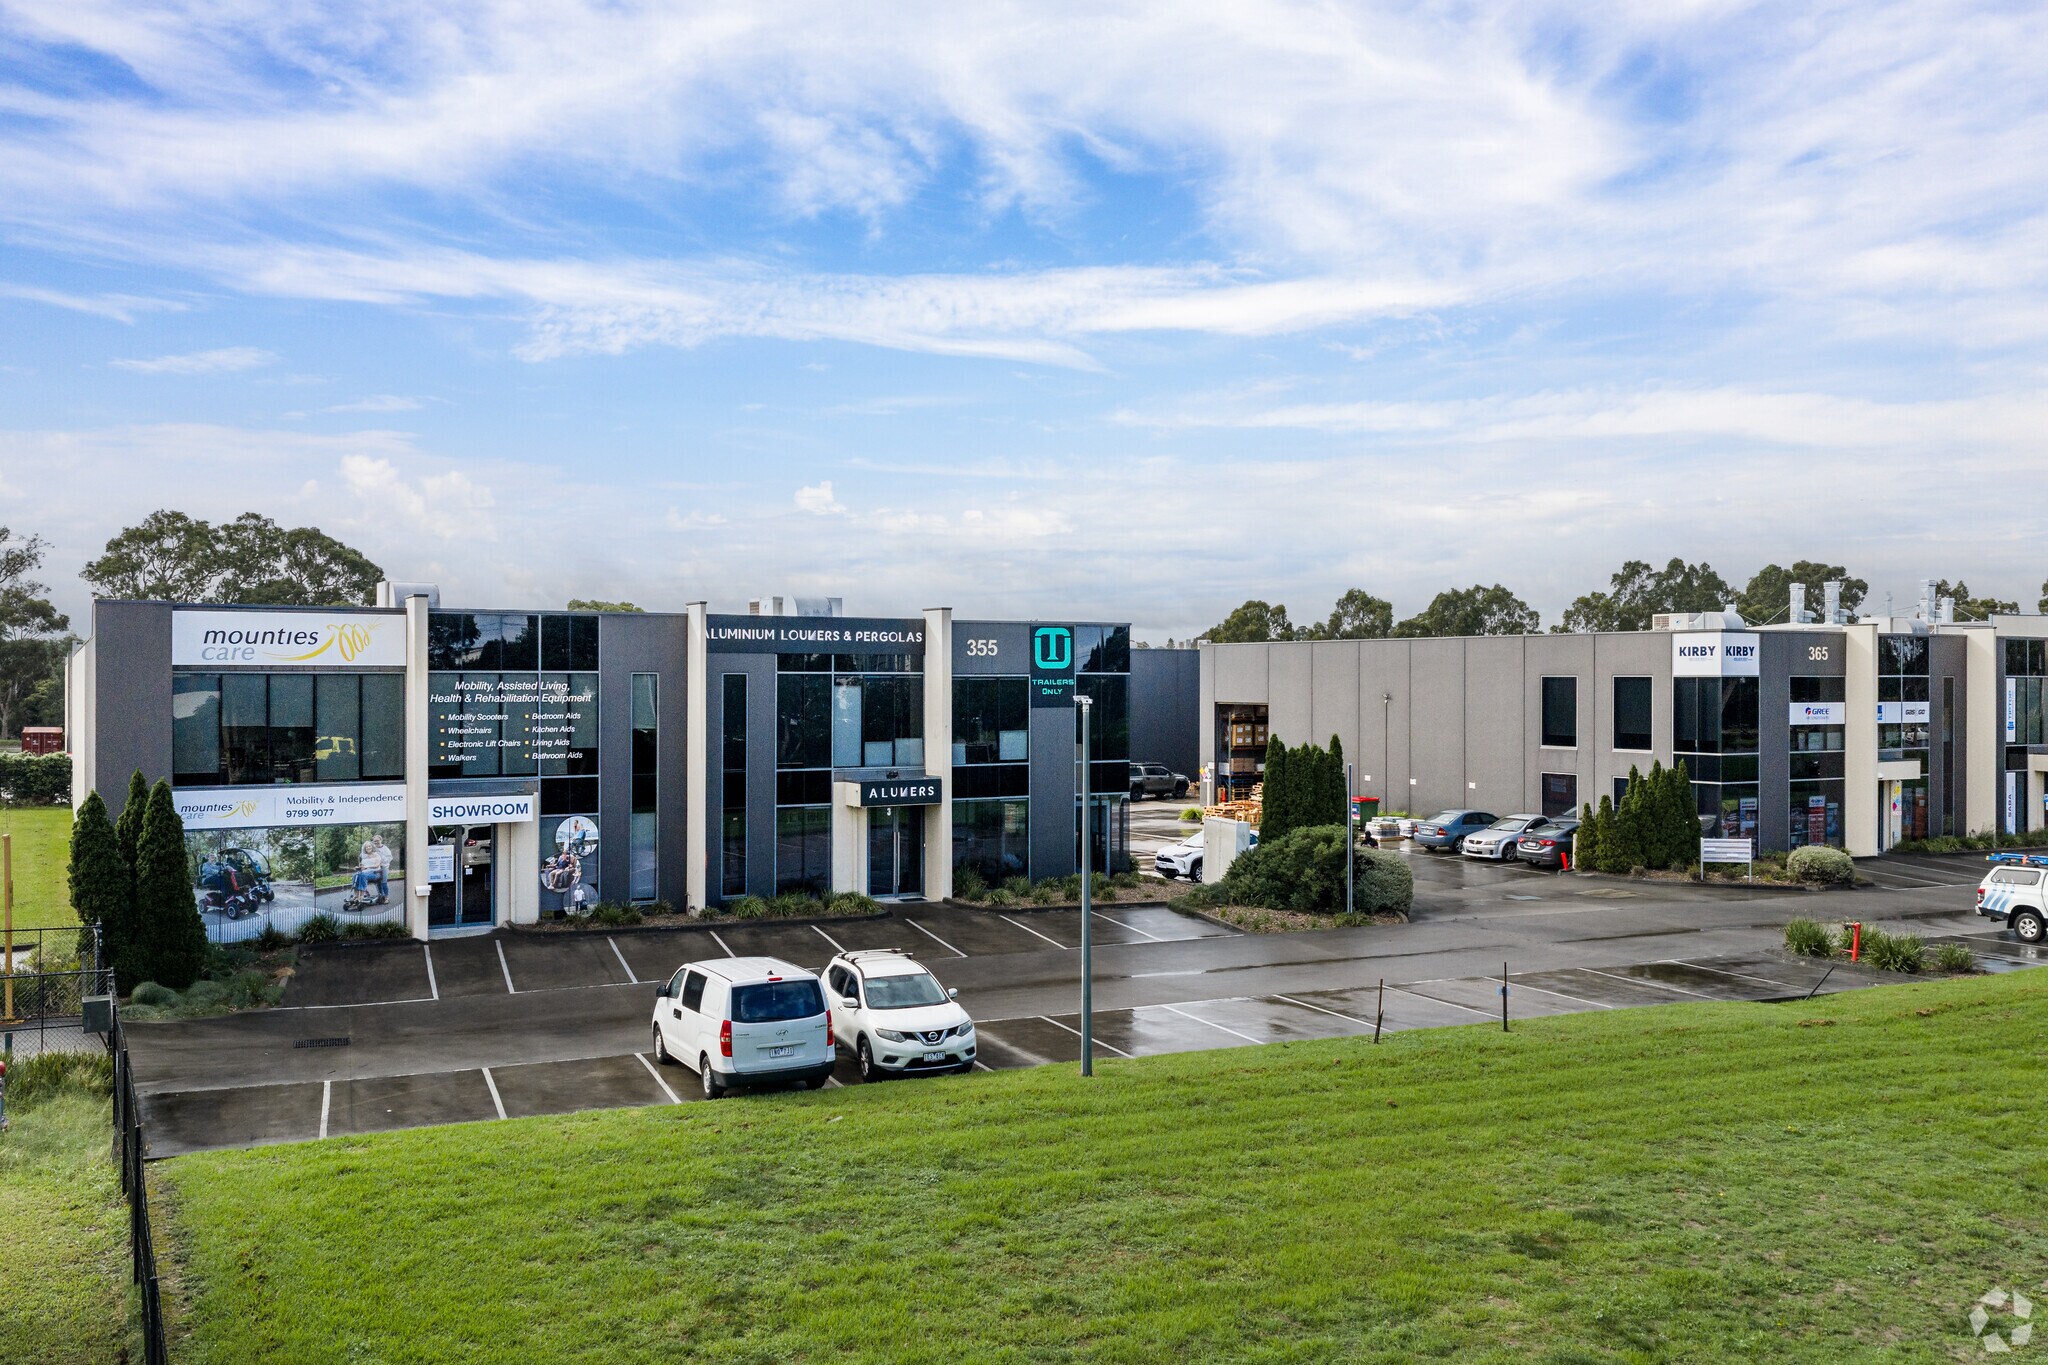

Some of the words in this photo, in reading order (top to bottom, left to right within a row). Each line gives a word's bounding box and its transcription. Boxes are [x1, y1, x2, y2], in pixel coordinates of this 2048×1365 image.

[203, 628, 319, 645] mounties
[843, 631, 852, 641] &
[855, 631, 923, 642] PERGOLAS
[966, 639, 998, 656] 355
[1679, 645, 1716, 657] KIRBY
[1725, 645, 1755, 657] KIRBY
[201, 646, 255, 661] care
[1808, 646, 1829, 661] 365
[454, 681, 494, 692] Mobility,
[496, 681, 538, 690] Assisted
[540, 681, 570, 692] Living,
[1042, 687, 1063, 695] ONLY
[430, 693, 462, 703] Health
[464, 693, 472, 703] &
[474, 693, 539, 703] Rehabilitation
[541, 693, 592, 704] Equipment
[531, 712, 564, 720] Bedroom
[565, 712, 581, 720] Aids
[1812, 707, 1830, 715] GREE
[447, 713, 476, 722] Mobility
[476, 713, 509, 721] Scooters
[447, 727, 492, 735] Wheelchairs
[559, 725, 576, 733] Aids
[447, 740, 484, 748] Electronic
[497, 739, 521, 747] Chairs
[447, 754, 477, 762] Walkers
[531, 752, 566, 760] Bathroom
[566, 751, 583, 759] Aids
[286, 795, 325, 805] Mobility
[327, 795, 336, 804] &
[338, 793, 404, 804] Independence
[180, 803, 233, 813] mounties
[286, 809, 310, 818] 9799
[311, 808, 334, 817] 9077
[432, 803, 529, 818] SHOWROOM
[886, 807, 892, 816] 3
